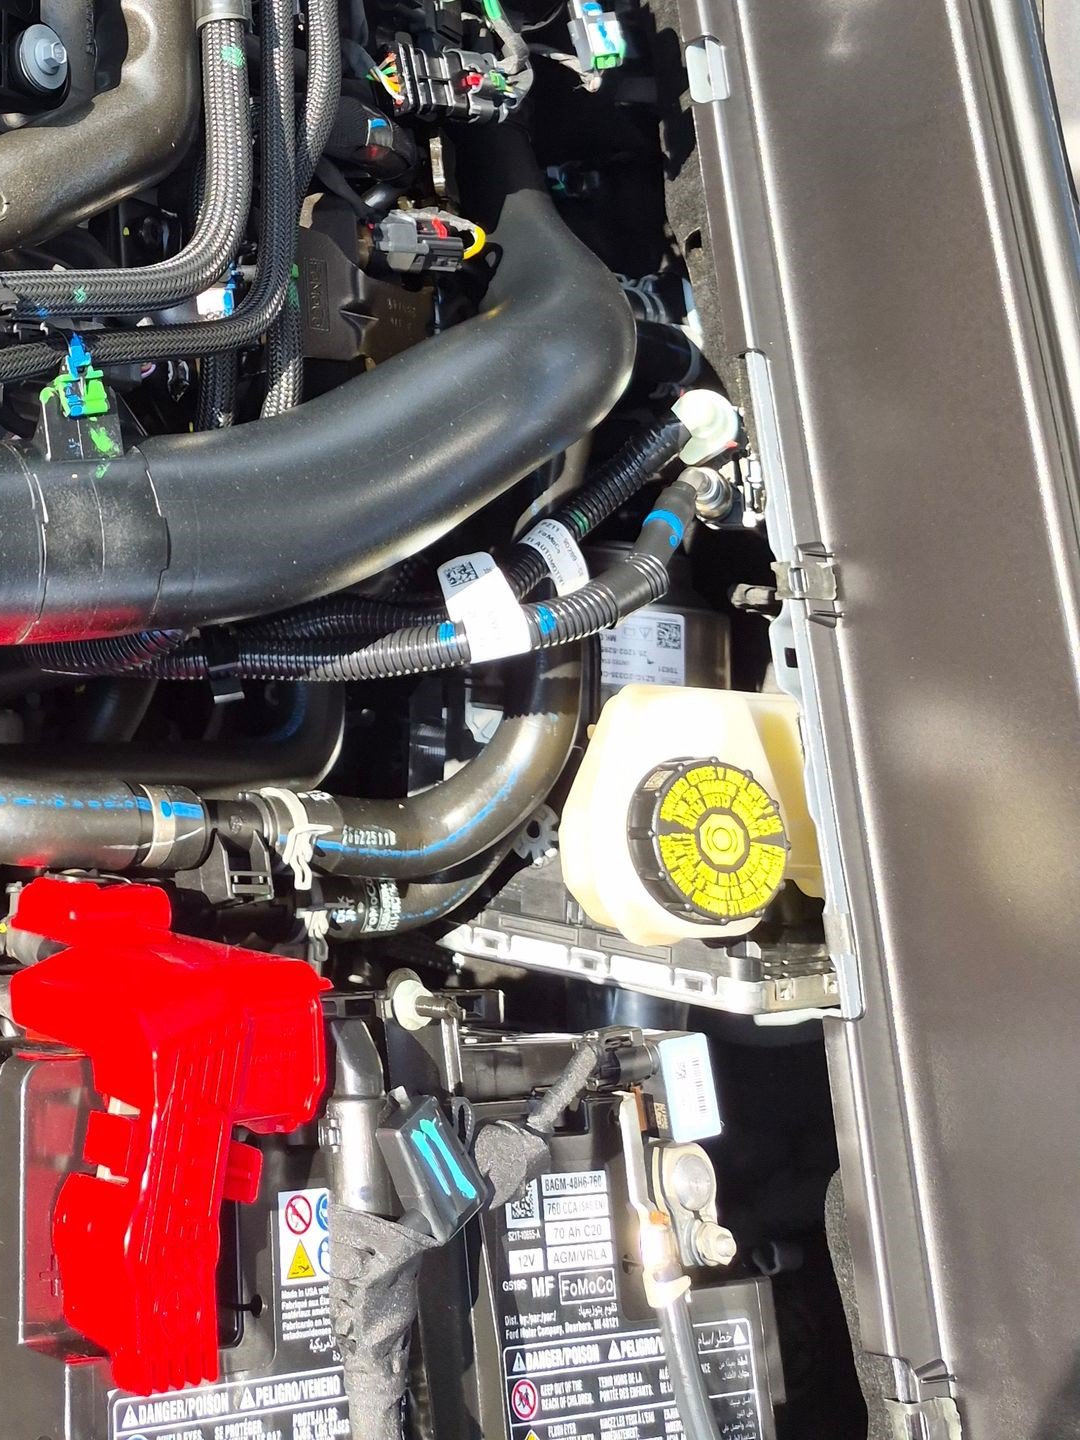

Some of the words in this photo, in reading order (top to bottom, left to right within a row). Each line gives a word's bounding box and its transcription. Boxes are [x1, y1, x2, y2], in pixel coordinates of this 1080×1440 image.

[547, 1203, 560, 1216] 760
[562, 1201, 578, 1215] CCA
[554, 1227, 565, 1239] 70
[568, 1225, 581, 1238] Ah
[584, 1224, 602, 1236] C20
[518, 1254, 535, 1267] 12V
[553, 1248, 607, 1264] AGM/VRLA
[305, 1286, 319, 1298] USA
[531, 1275, 555, 1298] MF
[561, 1276, 613, 1297] FoMoCo
[506, 1329, 520, 1340] Ford
[525, 1344, 600, 1371] DANGER/POISON
[138, 1392, 229, 1424] DANGER/POISON
[256, 1374, 341, 1407] PELIGRO/VENENO
